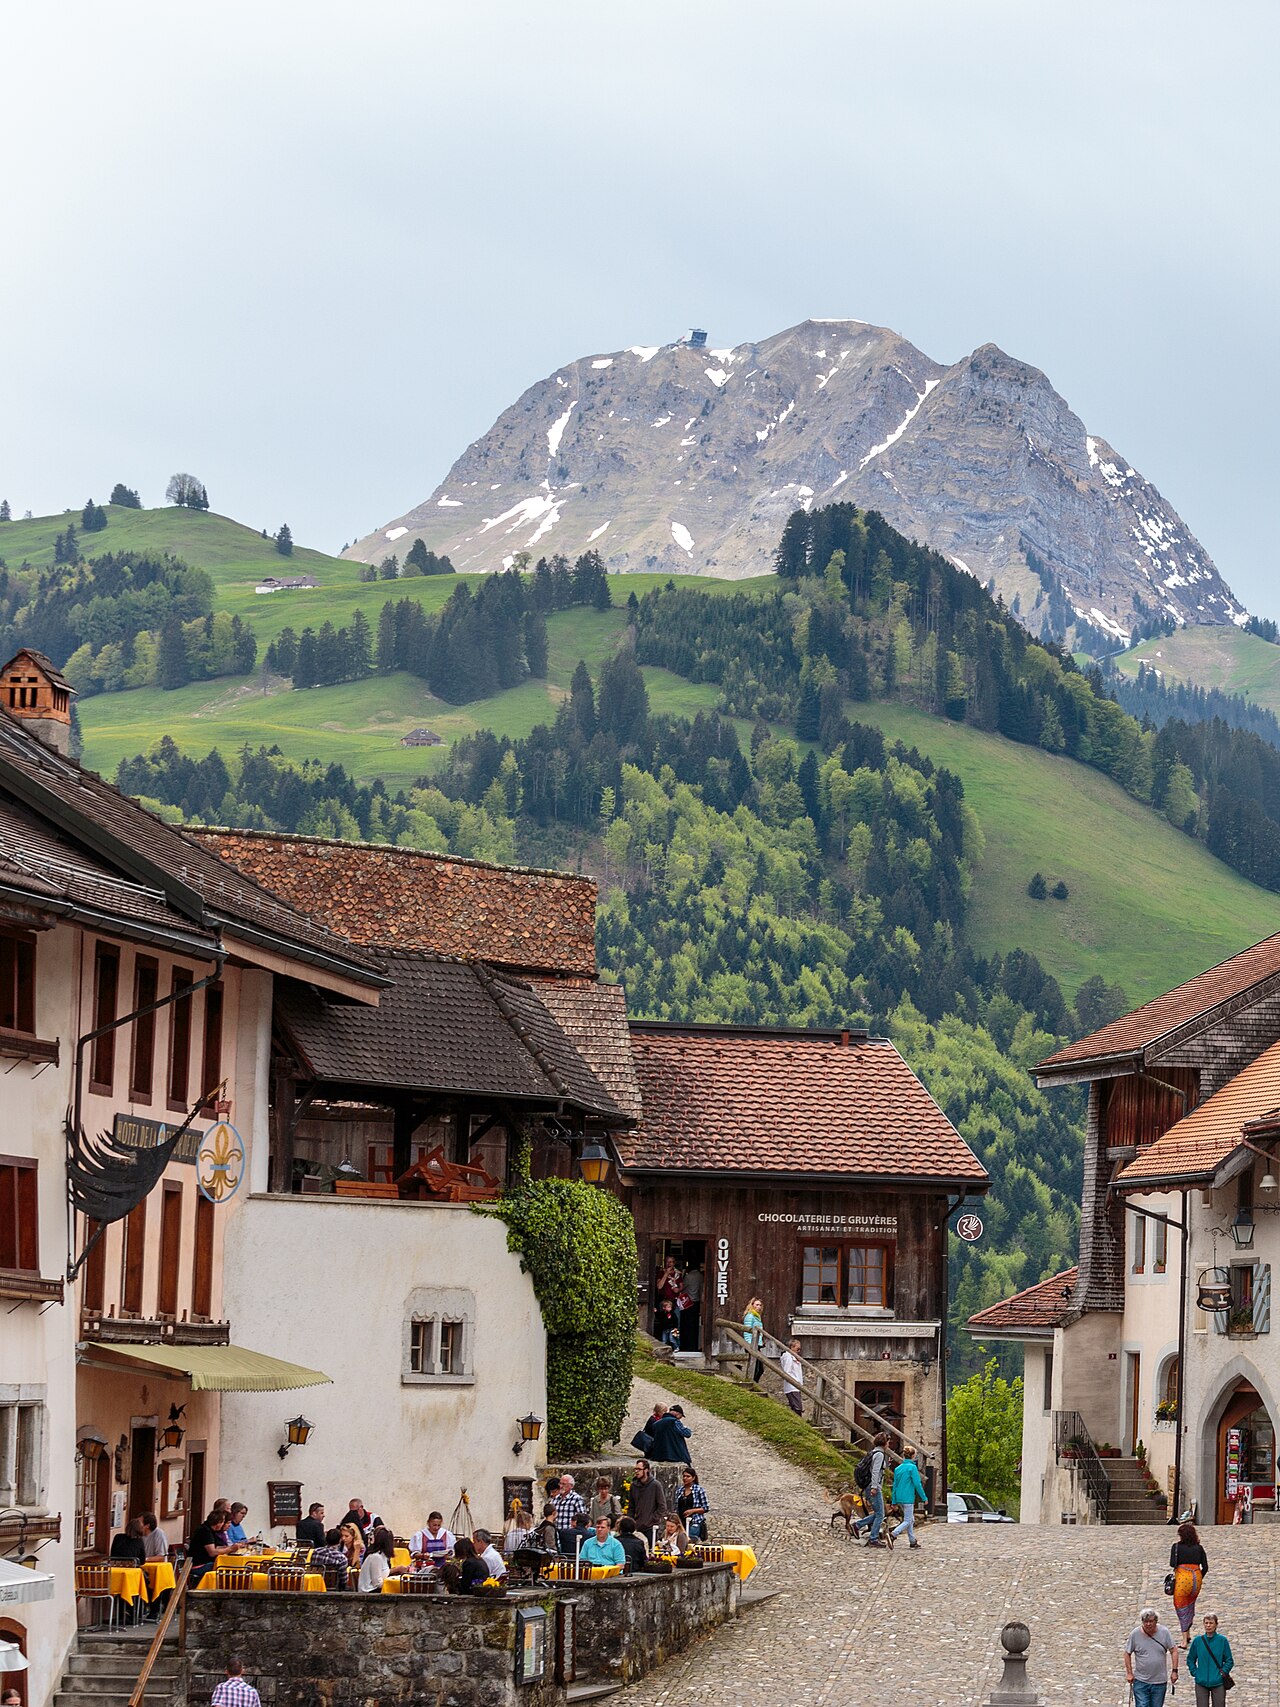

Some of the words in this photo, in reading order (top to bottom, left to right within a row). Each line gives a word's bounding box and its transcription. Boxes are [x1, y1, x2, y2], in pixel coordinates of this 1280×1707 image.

[116, 1120, 139, 1148] HOTEL
[758, 1213, 831, 1224] CHOCOLATERIE
[833, 1215, 846, 1224] DE
[848, 1214, 898, 1225] GRUYÈRES
[717, 1238, 729, 1305] OUVERT
